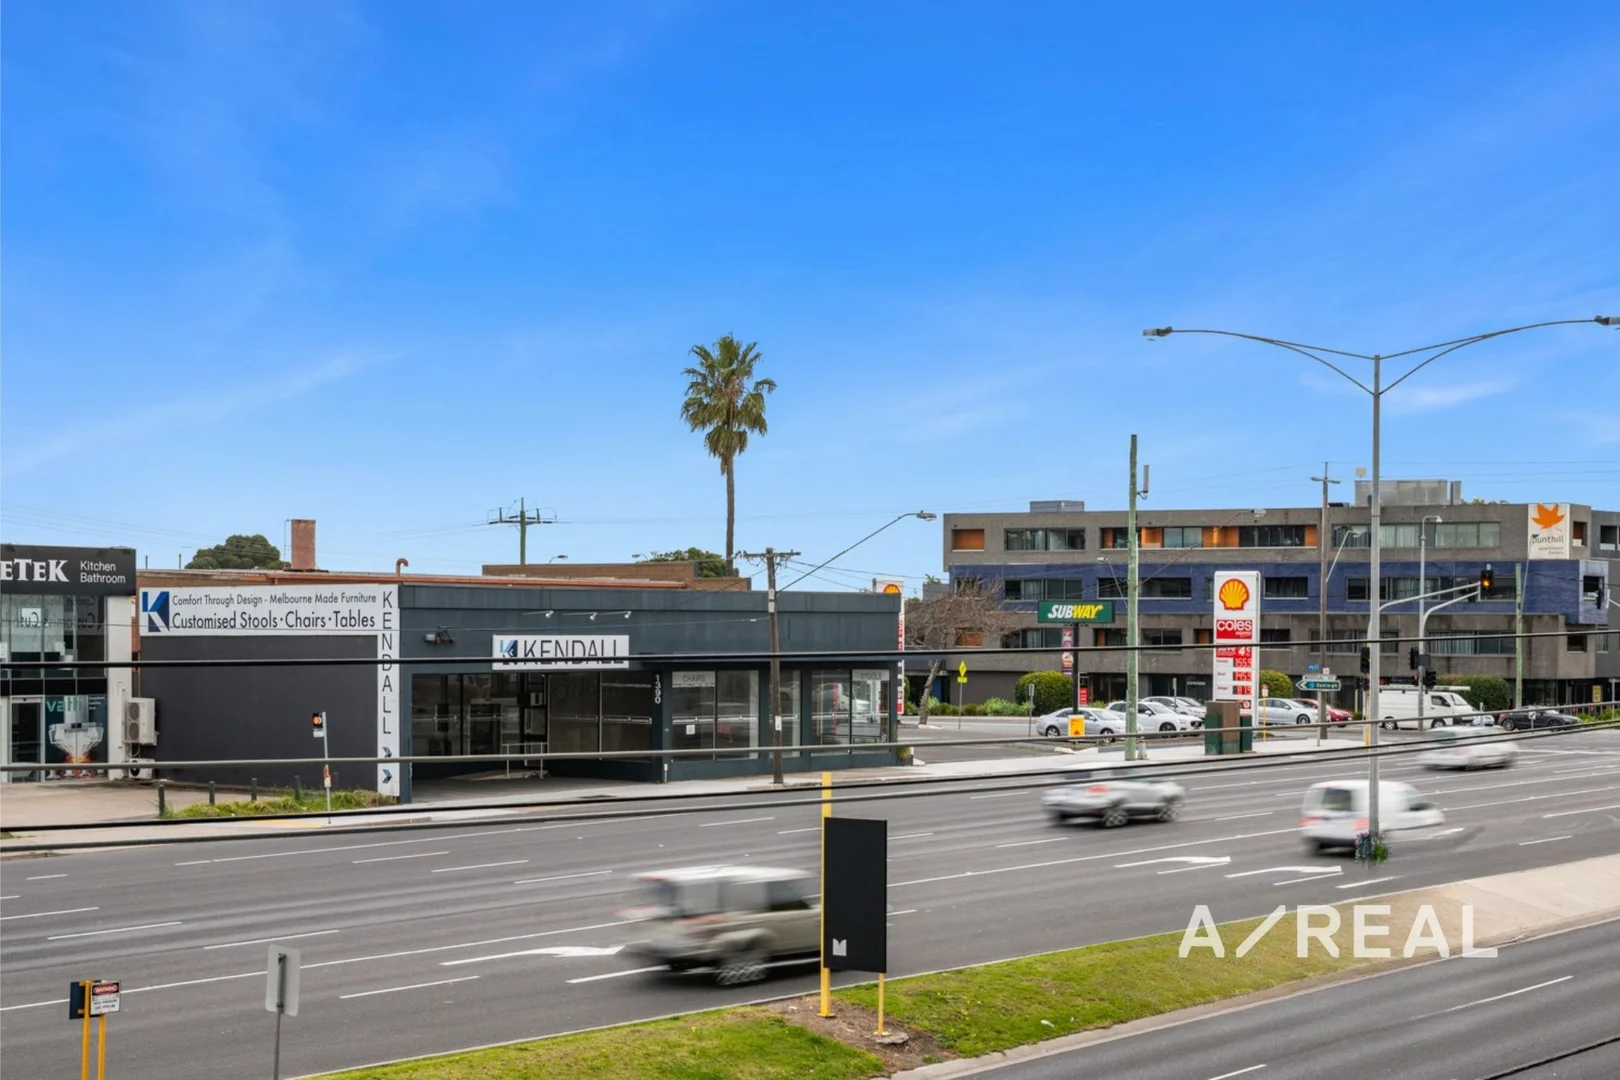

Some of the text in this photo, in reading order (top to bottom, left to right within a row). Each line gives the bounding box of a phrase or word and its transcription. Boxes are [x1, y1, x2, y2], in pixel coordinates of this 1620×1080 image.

[80, 560, 116, 572] Kitchen
[80, 572, 126, 584] Bathroom
[172, 592, 376, 608] Comfort Through Design Melbourne Made Furniture
[172, 609, 375, 628] Customised Stools Chairs Tables
[1048, 604, 1103, 619] SUBWAY
[1217, 620, 1252, 631] coles
[524, 640, 624, 665] KENDALL
[382, 591, 393, 734] KENDALL
